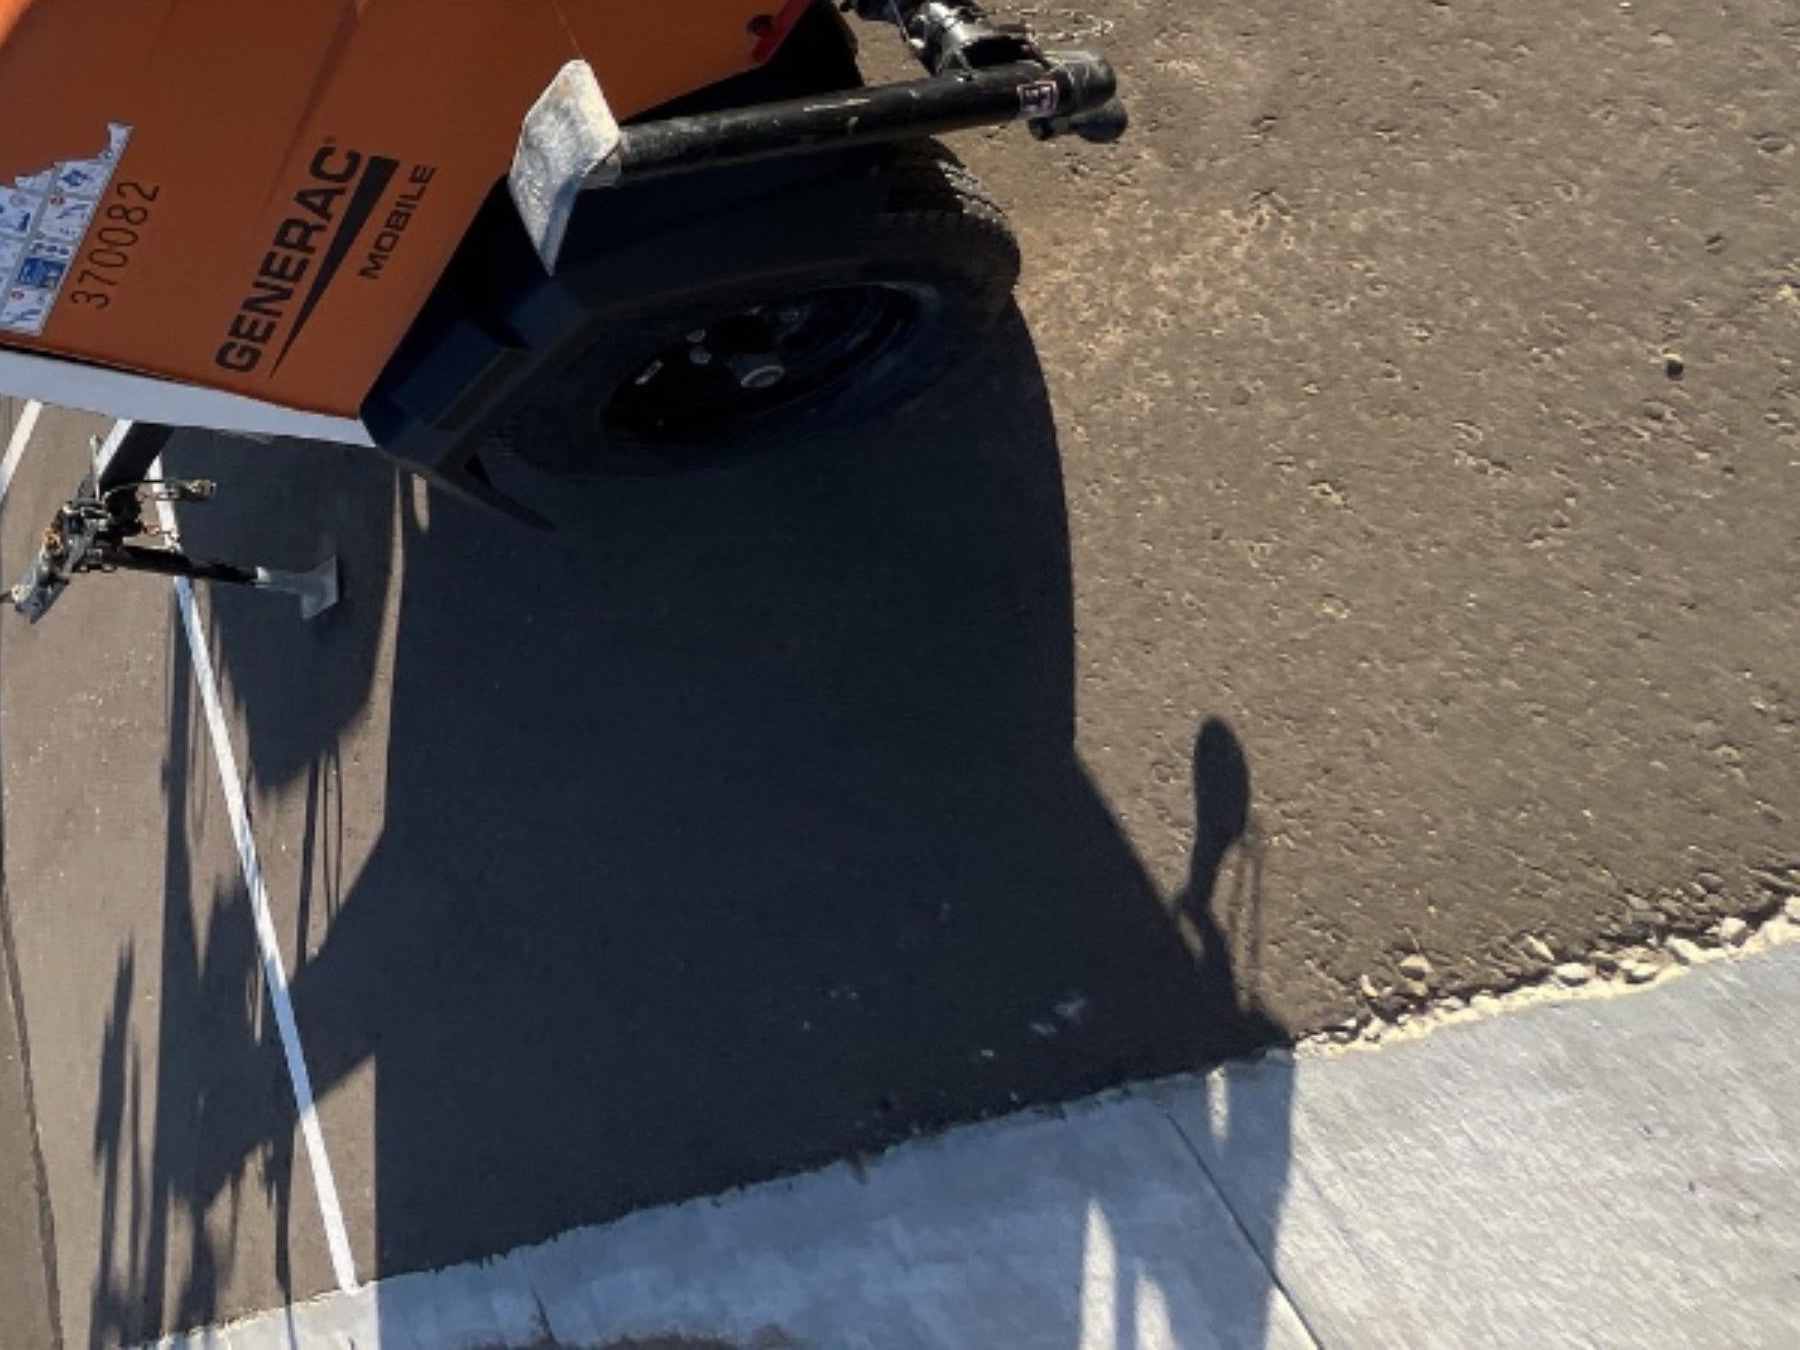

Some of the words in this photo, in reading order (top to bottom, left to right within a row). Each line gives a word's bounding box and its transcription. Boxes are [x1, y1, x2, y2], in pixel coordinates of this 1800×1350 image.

[70, 179, 161, 309] 370082
[214, 143, 365, 375] GENERAC
[356, 163, 437, 282] MOBILE
